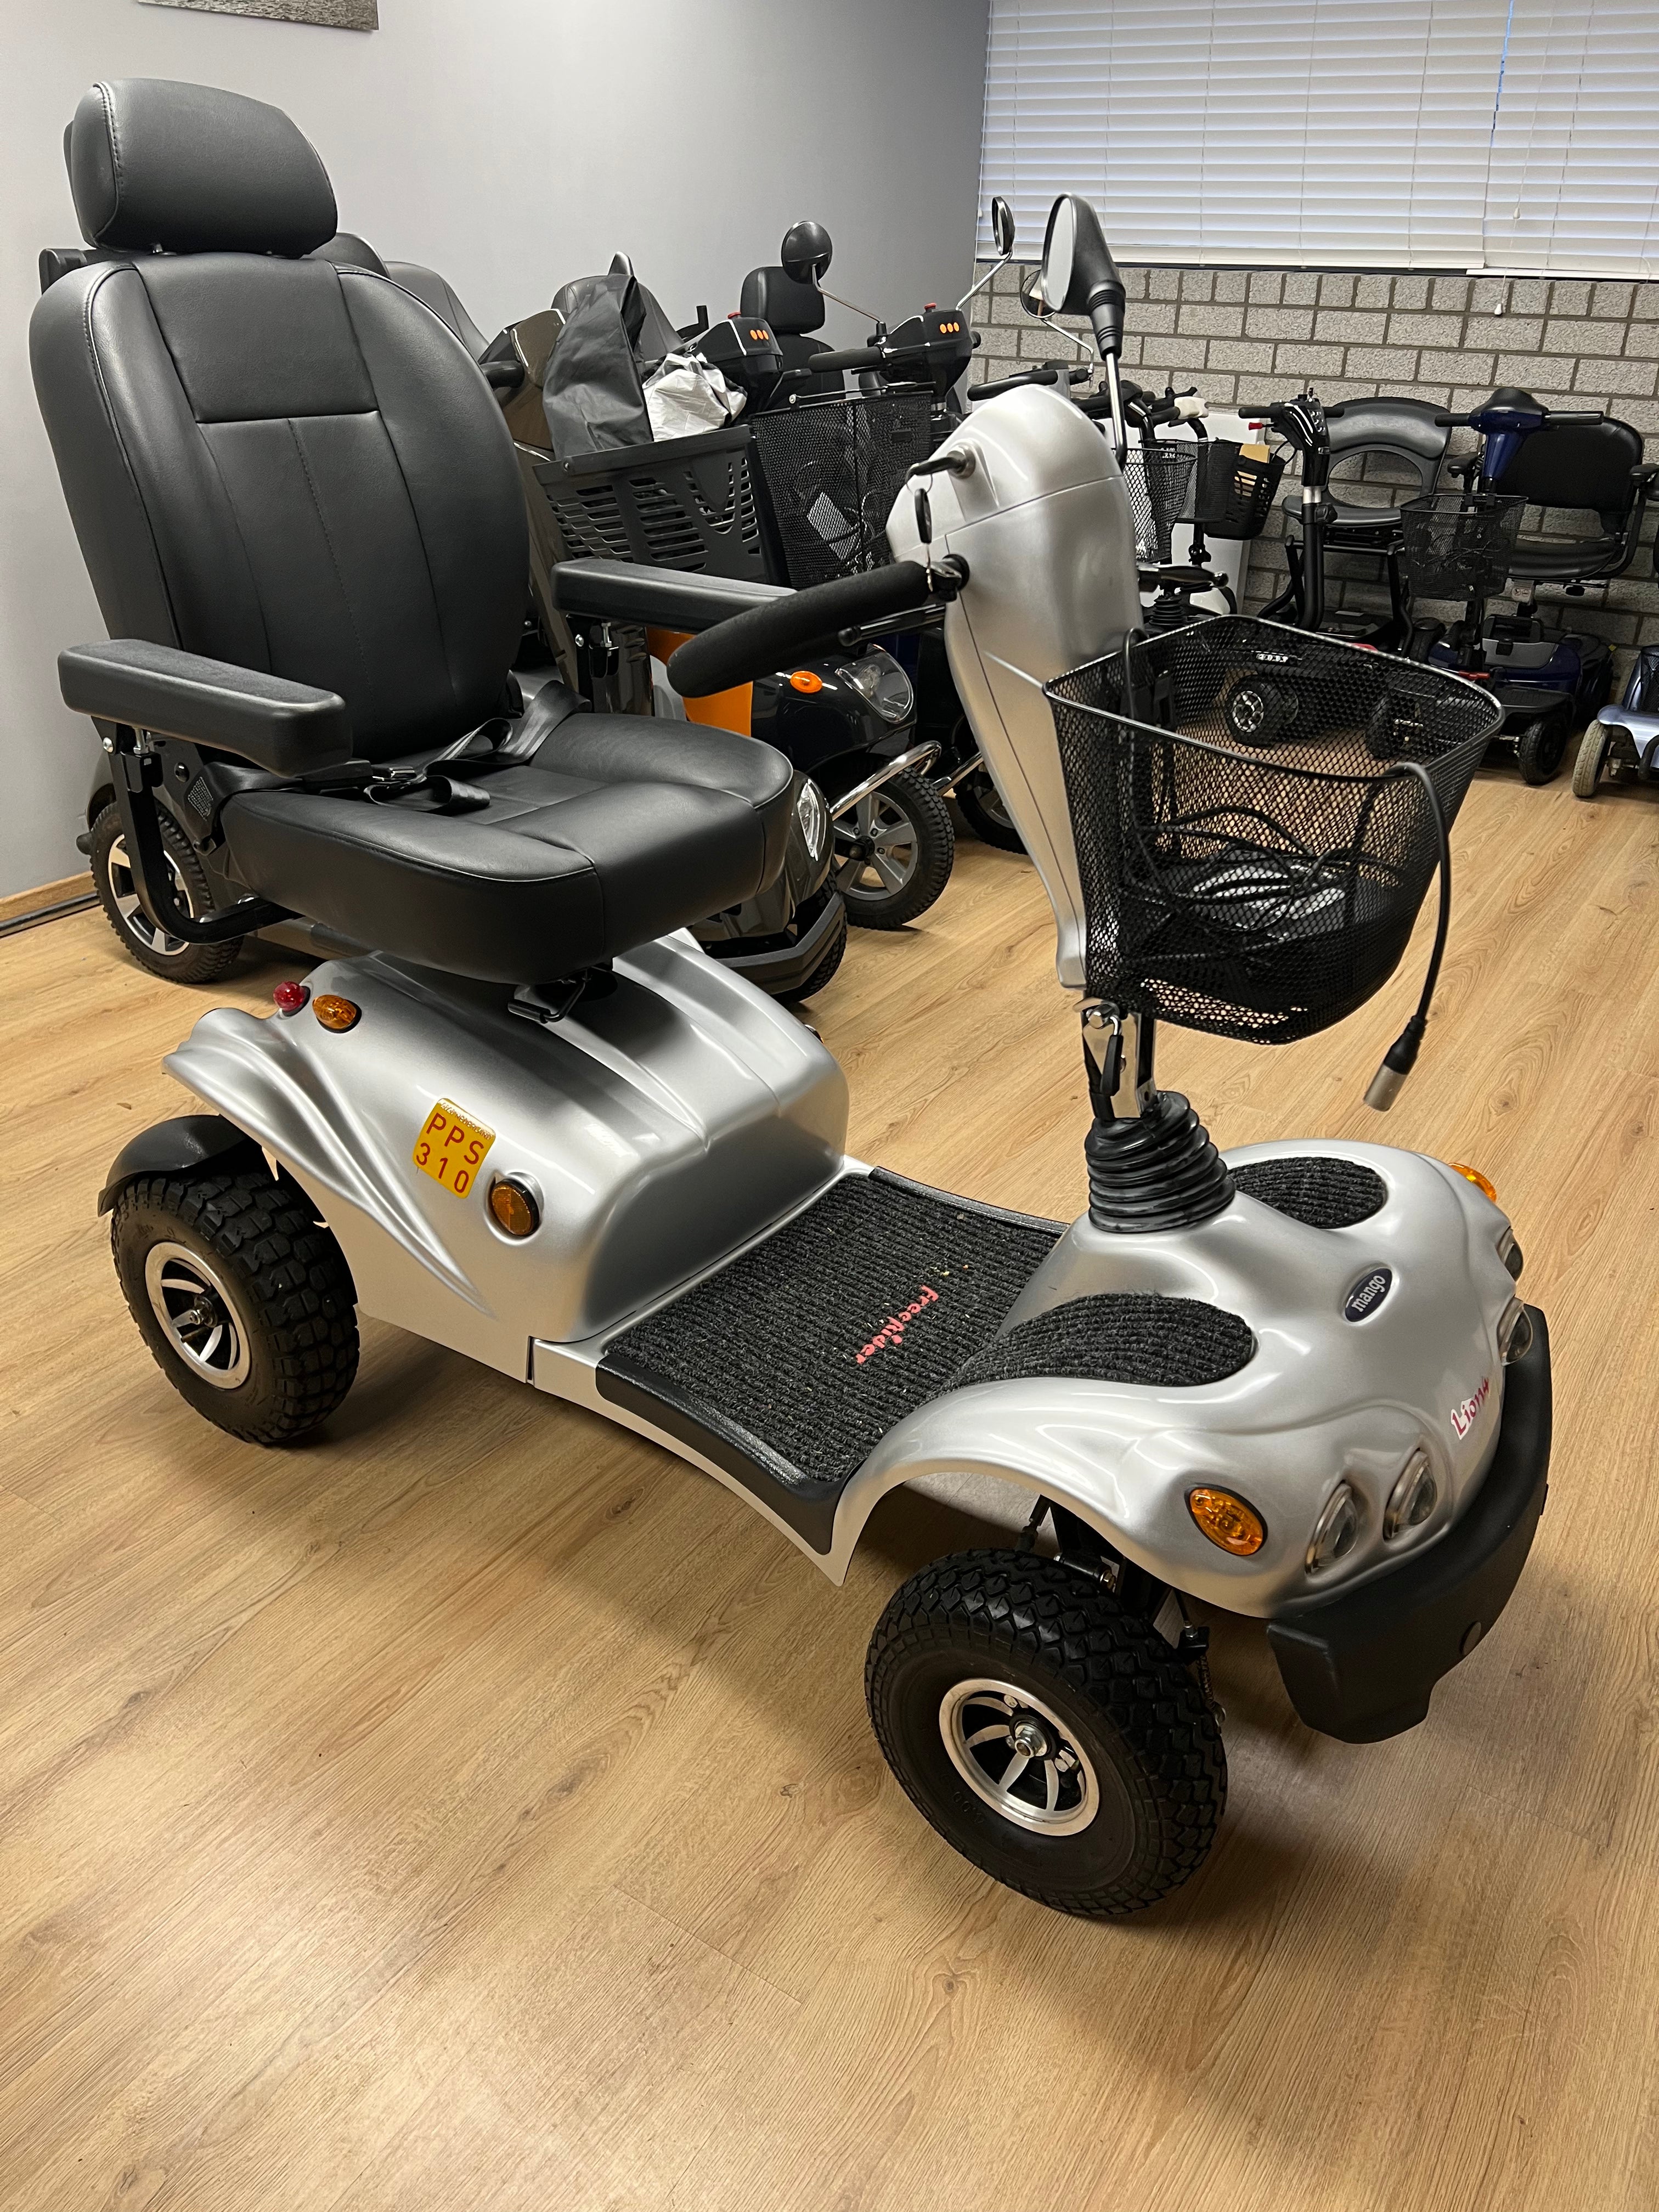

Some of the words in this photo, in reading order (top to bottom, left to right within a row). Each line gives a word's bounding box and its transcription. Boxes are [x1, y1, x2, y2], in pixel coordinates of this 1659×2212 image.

[427, 1113, 483, 1165] PPS
[416, 1143, 469, 1193] 310
[1351, 1276, 1386, 1312] mango
